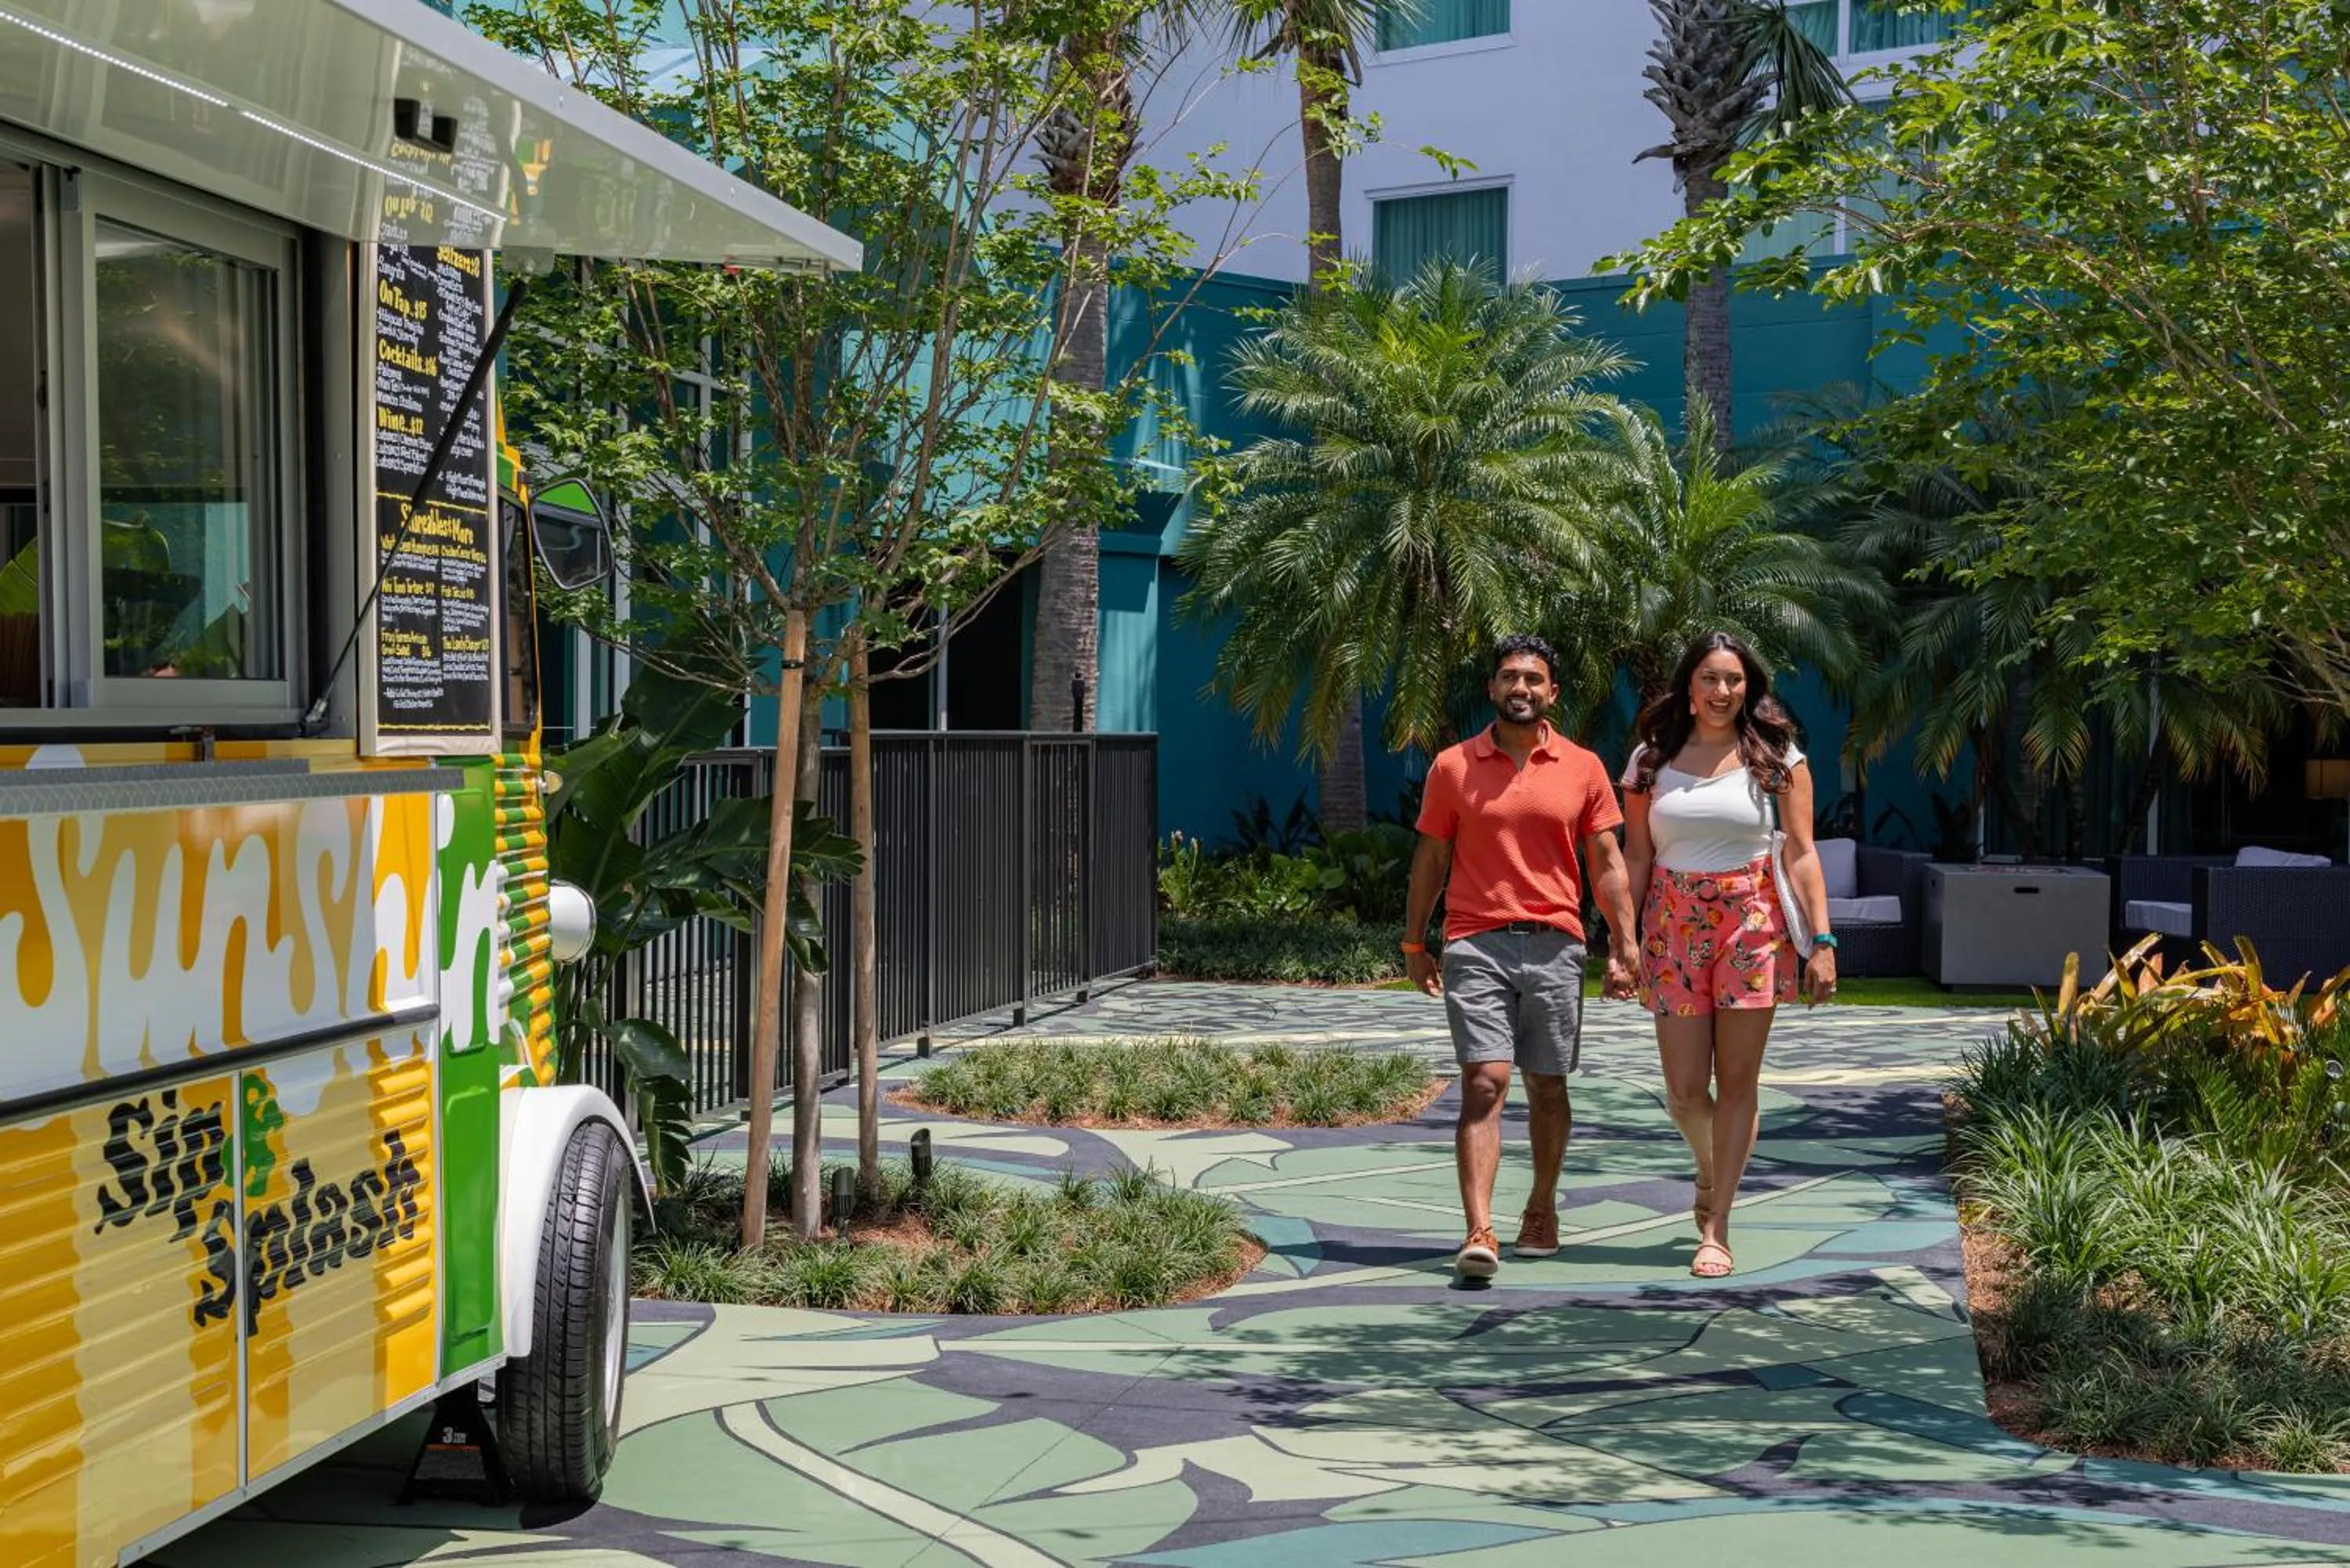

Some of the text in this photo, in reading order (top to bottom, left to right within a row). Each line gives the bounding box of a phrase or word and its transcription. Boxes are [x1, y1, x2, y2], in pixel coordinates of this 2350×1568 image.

[95, 1089, 226, 1243] Sip
[193, 1128, 421, 1339] Splash
[442, 1426, 454, 1443] 3
